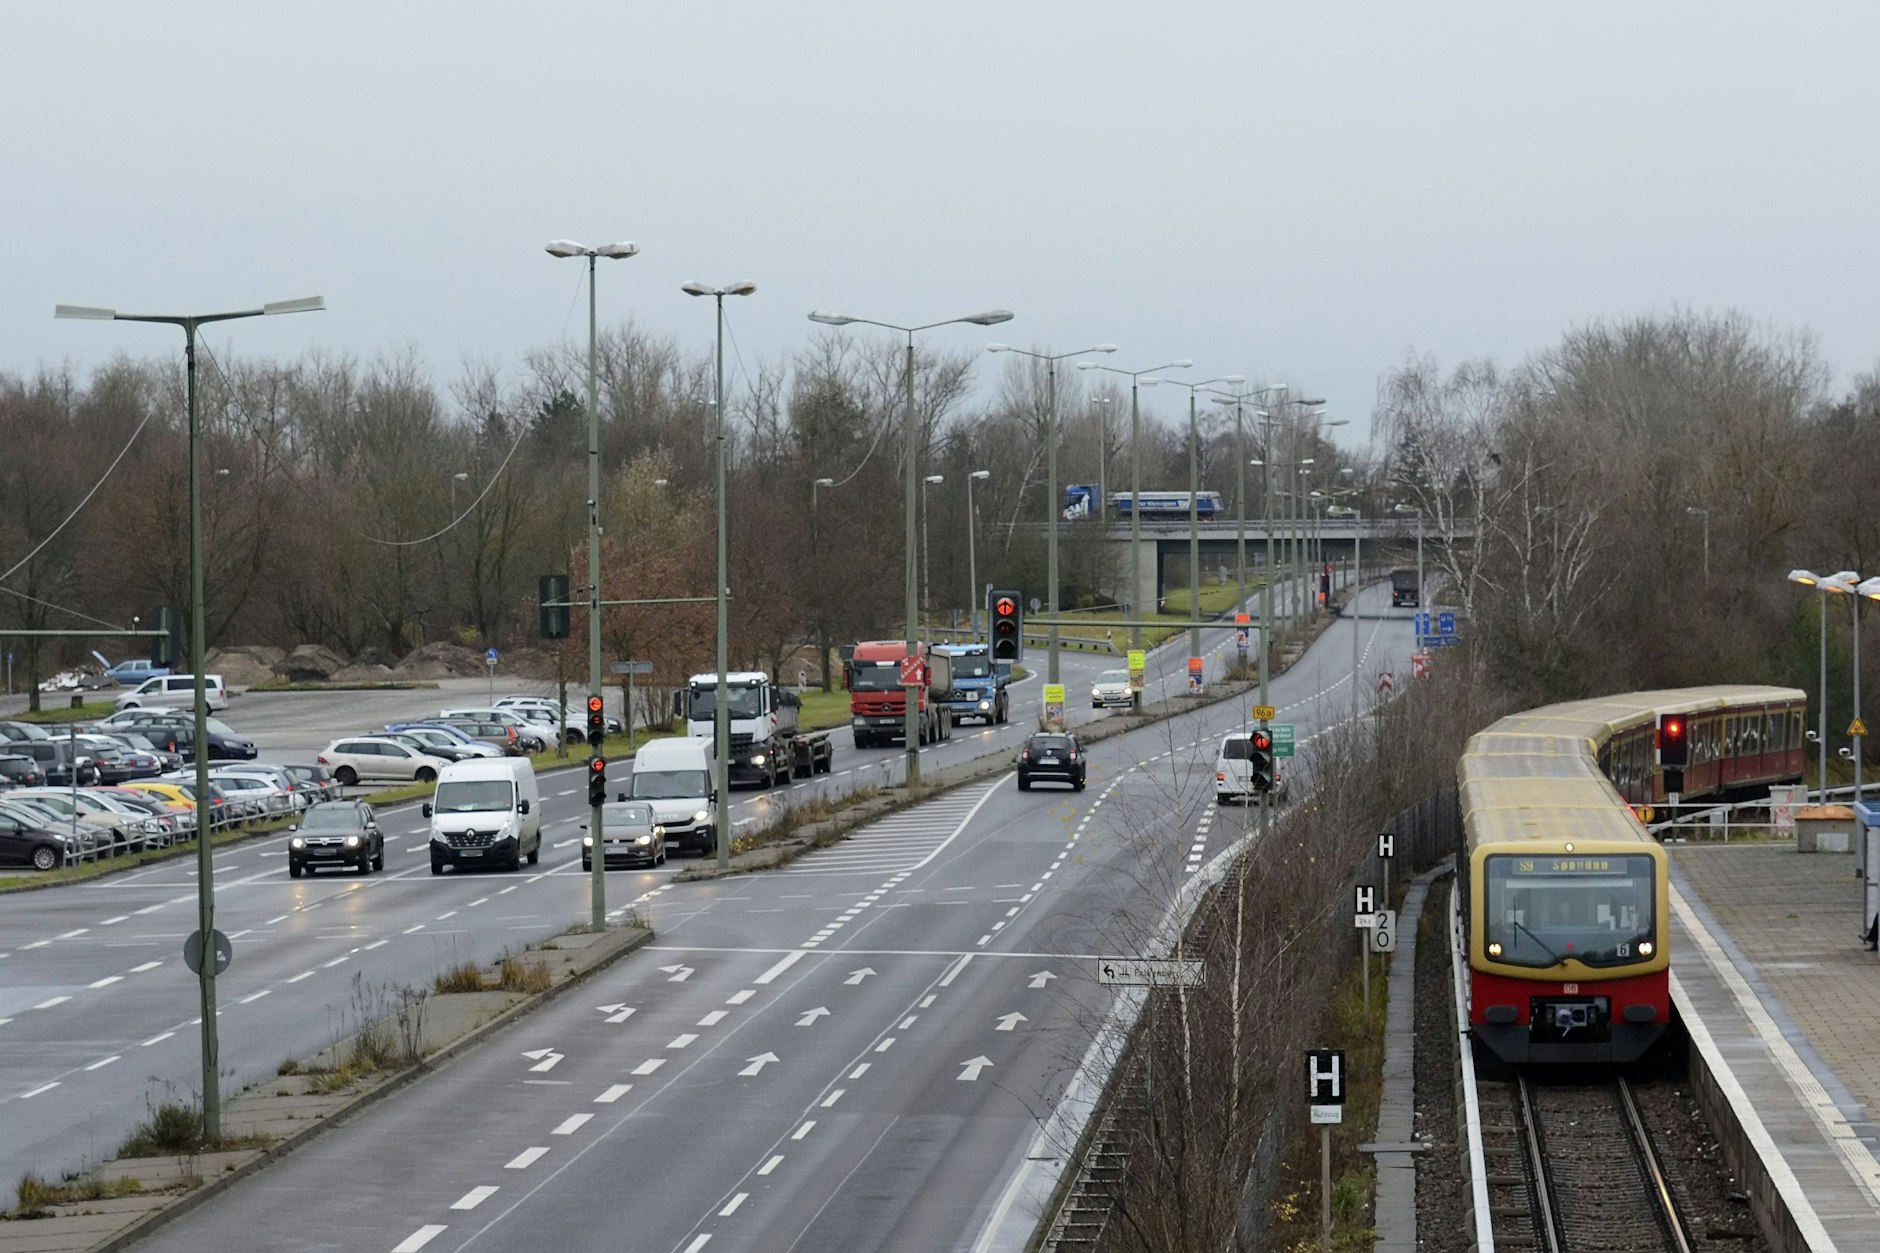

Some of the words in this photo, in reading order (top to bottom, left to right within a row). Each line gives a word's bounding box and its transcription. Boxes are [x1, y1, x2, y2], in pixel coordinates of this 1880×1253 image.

[1256, 708, 1265, 717] 96
[1266, 709, 1272, 717] a
[1379, 834, 1394, 857] H
[1519, 860, 1534, 872] S9
[1552, 859, 1609, 871] Spandau
[1356, 887, 1374, 913] H
[1310, 1055, 1340, 1097] H
